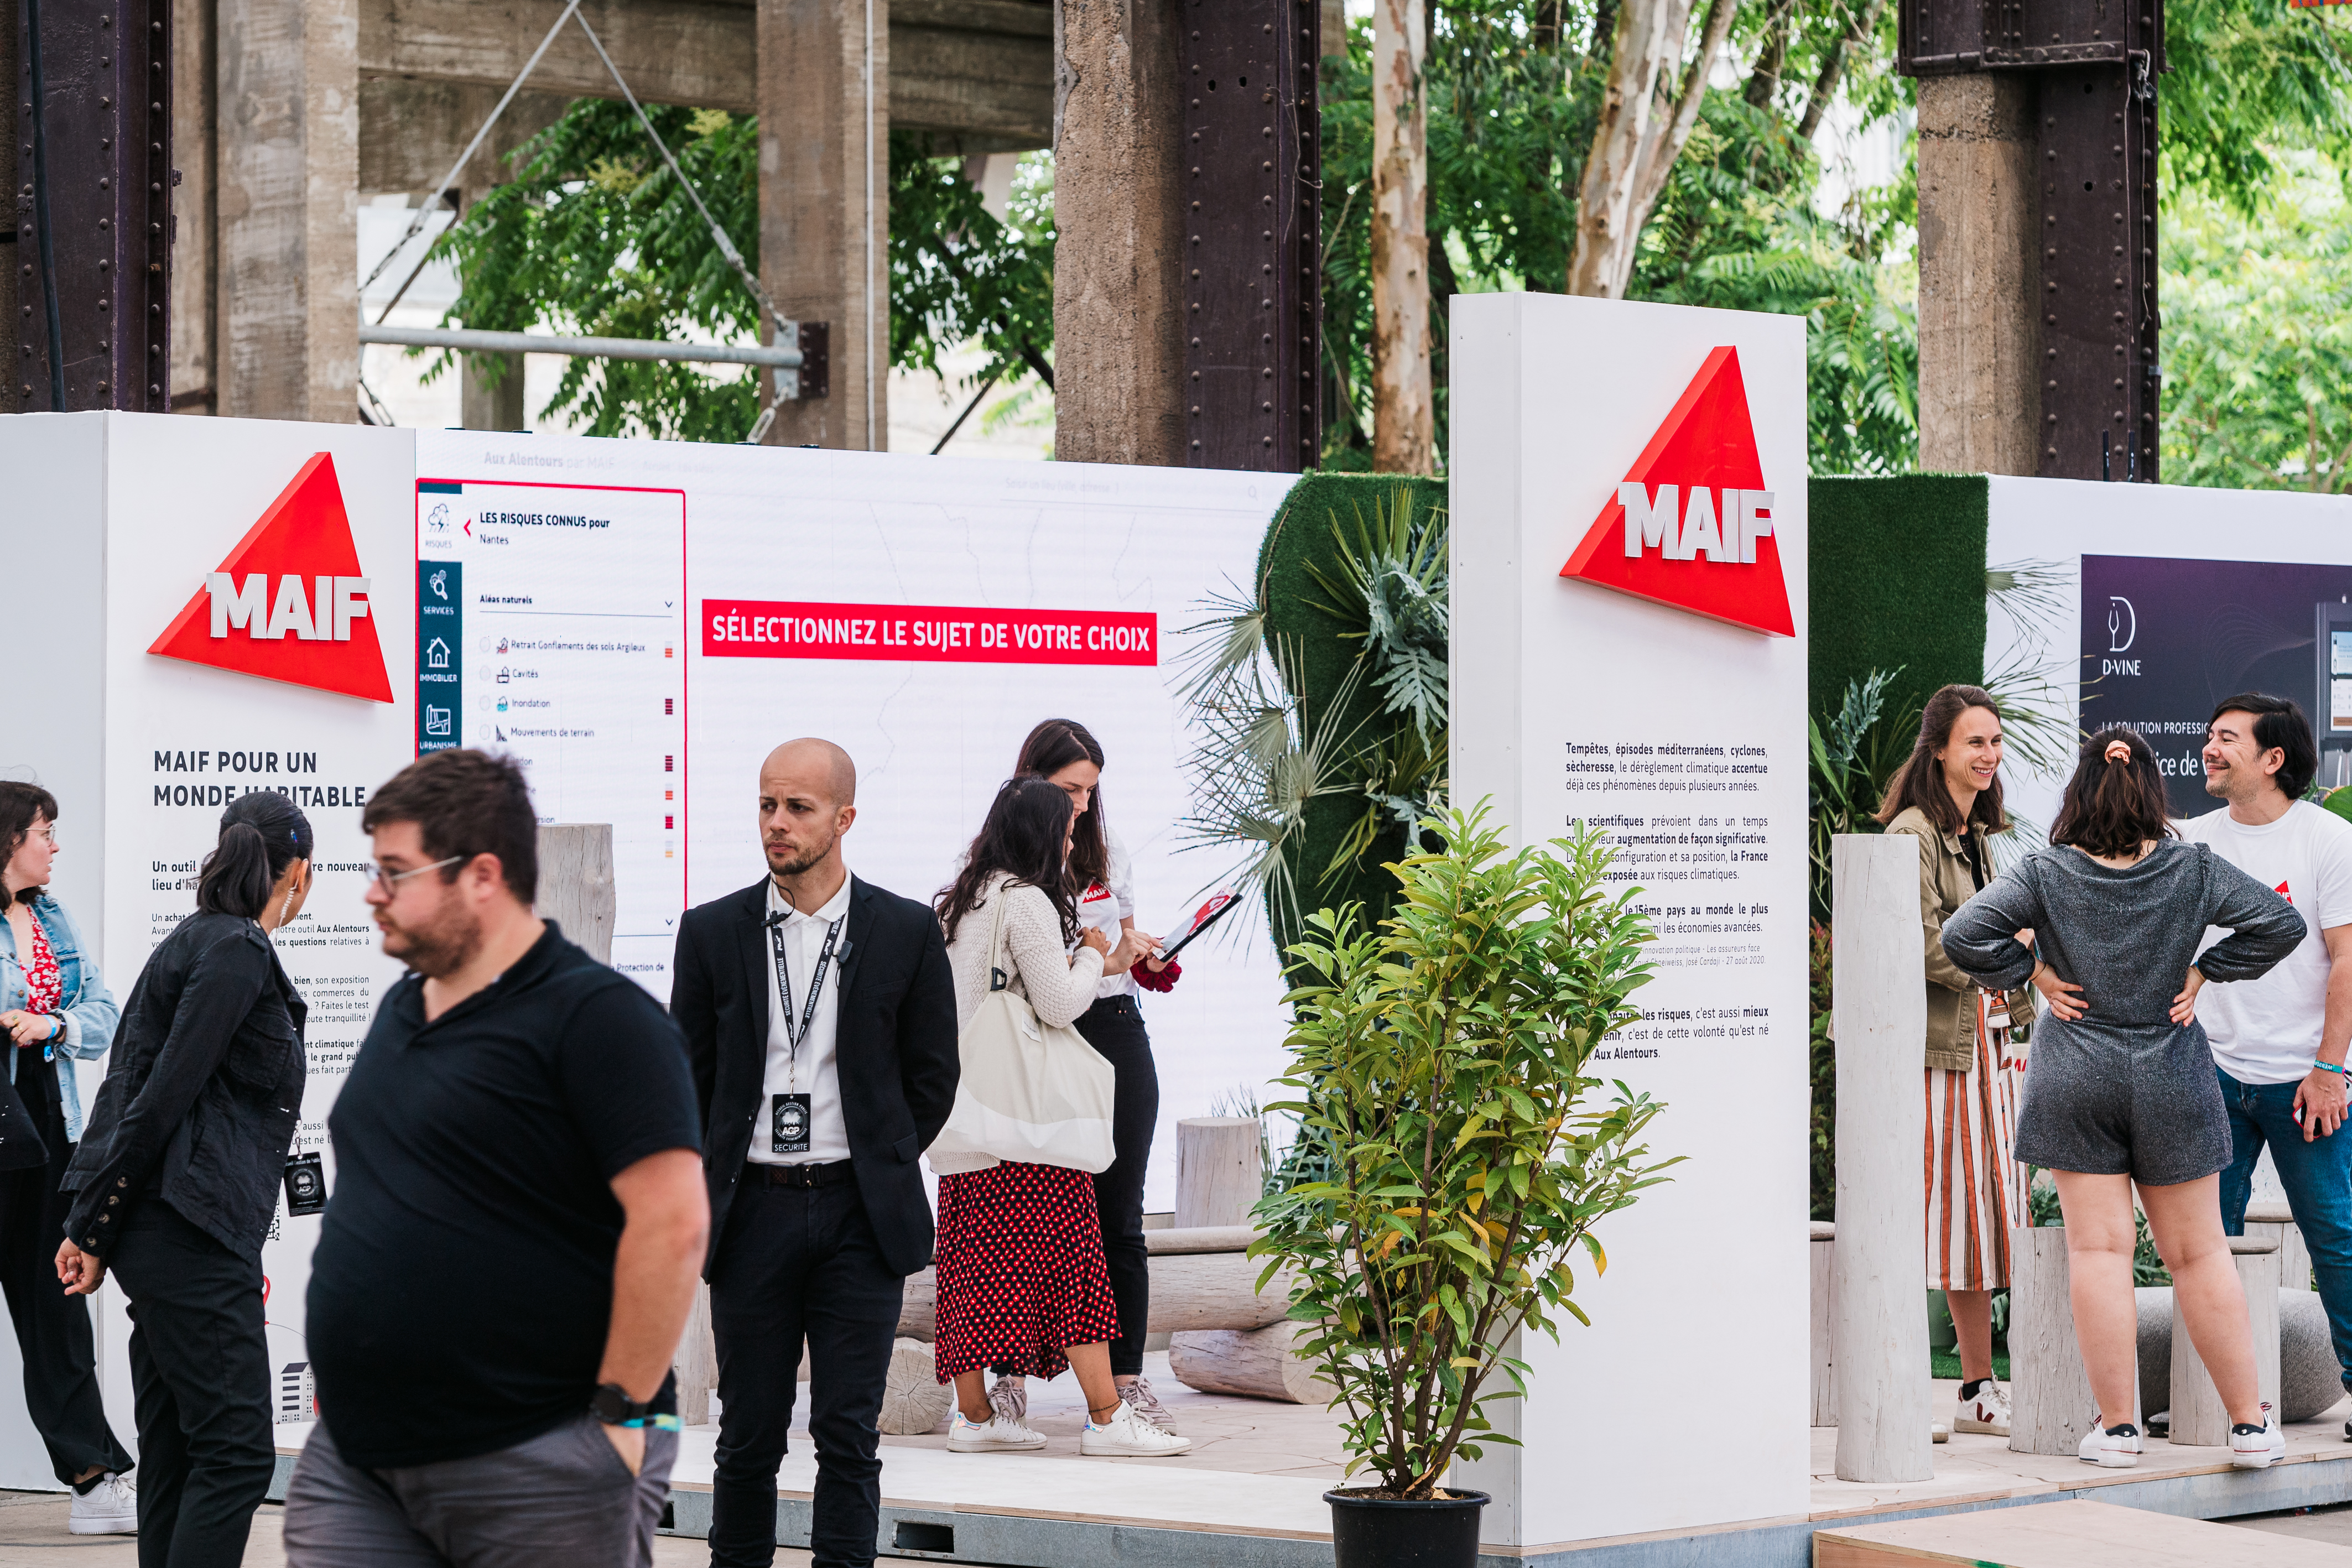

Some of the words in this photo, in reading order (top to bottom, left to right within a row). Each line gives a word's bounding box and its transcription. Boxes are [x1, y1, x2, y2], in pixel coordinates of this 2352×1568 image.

[485, 452, 505, 464] Aux
[509, 452, 563, 467] Alentours
[480, 512, 497, 523] LES
[501, 513, 543, 527] RISQUES
[546, 515, 586, 527] CONNUS
[589, 520, 610, 529] pour
[1618, 482, 1775, 563] MAIF
[425, 540, 451, 549] RISQUES
[480, 534, 509, 545] Nantes
[206, 572, 371, 641] MAIF
[424, 607, 454, 616] SERVICES
[713, 608, 876, 644] SÉLECTIONNEZ
[883, 620, 907, 645] LE
[913, 621, 975, 652] SUJET
[981, 623, 1008, 648] DE
[1013, 624, 1081, 649] VOTRE
[1087, 626, 1149, 651] CHOIX
[512, 640, 535, 649] Retrait
[601, 642, 614, 651] sols
[617, 643, 645, 653] Argileux
[420, 674, 457, 683] IMMOBILIER
[513, 669, 538, 678] Cavités
[512, 699, 550, 707] Inondation
[511, 727, 556, 737] Mouvements
[559, 728, 568, 737] de
[1566, 742, 1610, 757] Tempêtes,
[1616, 743, 1653, 757] épisodes
[1658, 743, 1725, 758] méditerranéens,
[1731, 744, 1767, 758] cyclones,
[155, 751, 209, 772] MAIF
[218, 752, 278, 773] POUR
[287, 752, 316, 773] UN
[1567, 760, 1616, 774] sècheresse,
[1620, 760, 1627, 772] le
[1631, 760, 1683, 775] dérèglement
[1687, 762, 1729, 776] climatique
[1732, 764, 1767, 773] accentue
[2180, 749, 2198, 776] de
[1567, 778, 1583, 793] déjà
[1603, 779, 1656, 793] phénomènes
[1659, 779, 1686, 793] depuis
[1689, 779, 1726, 793] plusieurs
[1729, 780, 1759, 791] années.
[154, 785, 236, 806] MONDE
[246, 786, 366, 807] BITABLE
[1567, 815, 1581, 826] Le
[1589, 815, 1644, 829] scientifiques
[1652, 816, 1691, 829] prévoient
[1699, 815, 1718, 826] dans
[1725, 818, 1735, 826] un
[1743, 817, 1768, 829] temps
[1617, 833, 1676, 846] augmentation
[1679, 832, 1688, 844] de
[1691, 832, 1713, 847] façon
[1716, 832, 1767, 847] significative.
[1669, 852, 1678, 862] et
[1681, 853, 1689, 862] sa
[1693, 850, 1727, 864] position,
[1731, 850, 1737, 861] la
[1741, 851, 1768, 861] France
[153, 861, 166, 872] Un
[171, 861, 196, 872] outil
[1641, 872, 1654, 880] aux
[1658, 868, 1688, 882] risques
[1690, 868, 1739, 882] climatiques.
[153, 879, 171, 890] lieu
[1086, 888, 1106, 900] MAIF
[1626, 904, 1633, 915] le
[1635, 904, 1662, 915] 15ème
[1667, 907, 1685, 918] pays
[1706, 903, 1733, 914] monde
[1739, 903, 1746, 914] le
[1751, 903, 1768, 916] plus
[152, 914, 162, 922] Un
[298, 924, 314, 933] outil
[333, 924, 369, 933] Alentours
[1664, 922, 1675, 933] les
[1678, 921, 1721, 933] économies
[1724, 920, 1762, 932] avancées.
[290, 937, 326, 948] questions
[330, 937, 361, 945] relatives
[366, 936, 369, 945] à
[1675, 944, 1701, 954] politique
[1707, 944, 1716, 953] Les
[1749, 944, 1760, 952] face
[1686, 958, 1697, 967] José
[1726, 957, 1733, 965] 27
[1735, 956, 1747, 965] août
[1750, 955, 1766, 965] 2020.
[617, 963, 653, 972] Protection
[656, 963, 664, 971] de
[295, 976, 312, 986] bien,
[331, 975, 369, 986] exposition
[360, 987, 368, 996] du
[321, 1001, 343, 1009] Faites
[346, 1001, 352, 1009] le
[325, 1013, 366, 1024] tranquillité
[1642, 1009, 1655, 1020] les
[1658, 1008, 1692, 1023] risques,
[1696, 1007, 1715, 1019] c'est
[1719, 1006, 1740, 1018] aussi
[1744, 1005, 1768, 1017] mieux
[1628, 1028, 1648, 1040] c'est
[1653, 1027, 1663, 1039] de
[1667, 1028, 1689, 1038] cette
[1693, 1025, 1725, 1037] volonté
[1729, 1024, 1755, 1039] qu'est
[1759, 1023, 1768, 1035] né
[315, 1039, 354, 1049] climatique
[311, 1053, 318, 1061] le
[321, 1052, 342, 1063] grand
[1594, 1049, 1611, 1060] Aux
[1614, 1047, 1660, 1059] Alentours.
[321, 1065, 334, 1074] fait
[303, 1121, 323, 1130] aussi
[782, 1126, 800, 1135] AGP
[315, 1135, 324, 1144] né
